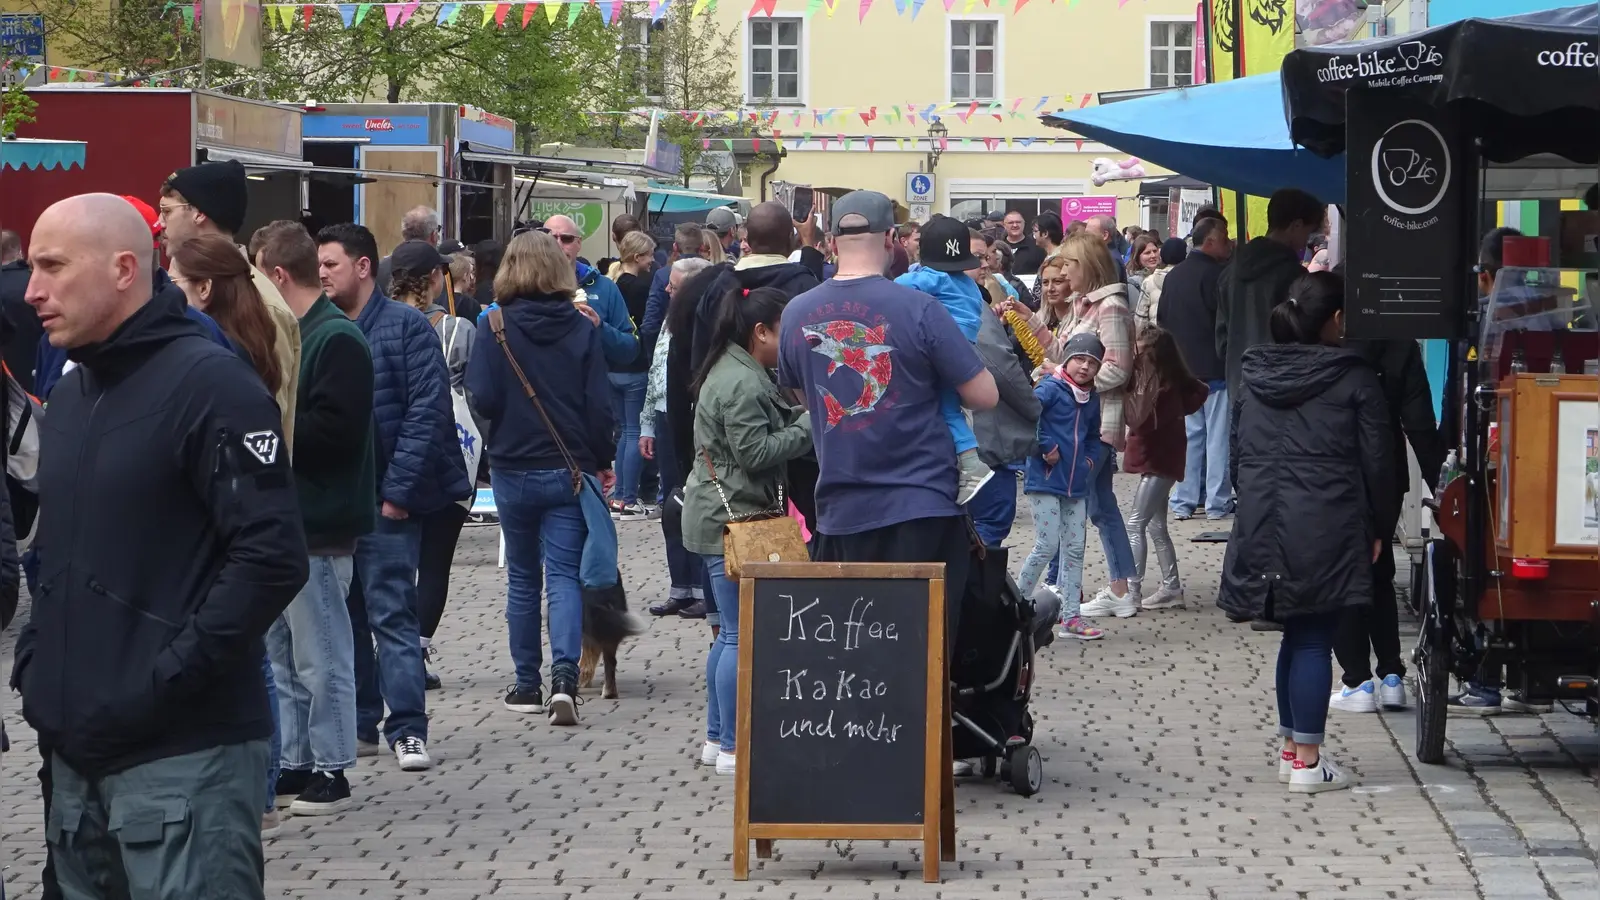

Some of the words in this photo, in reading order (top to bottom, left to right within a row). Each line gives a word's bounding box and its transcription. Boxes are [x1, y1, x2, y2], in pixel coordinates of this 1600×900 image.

[1537, 41, 1599, 68] coffe
[1368, 80, 1390, 88] Mobile
[1391, 76, 1412, 87] Coffee
[1413, 74, 1443, 83] Company
[1383, 214, 1439, 230] coffee-bike.com
[778, 594, 899, 651] Kaffee
[779, 709, 837, 738] und
[843, 711, 902, 743] mehr
